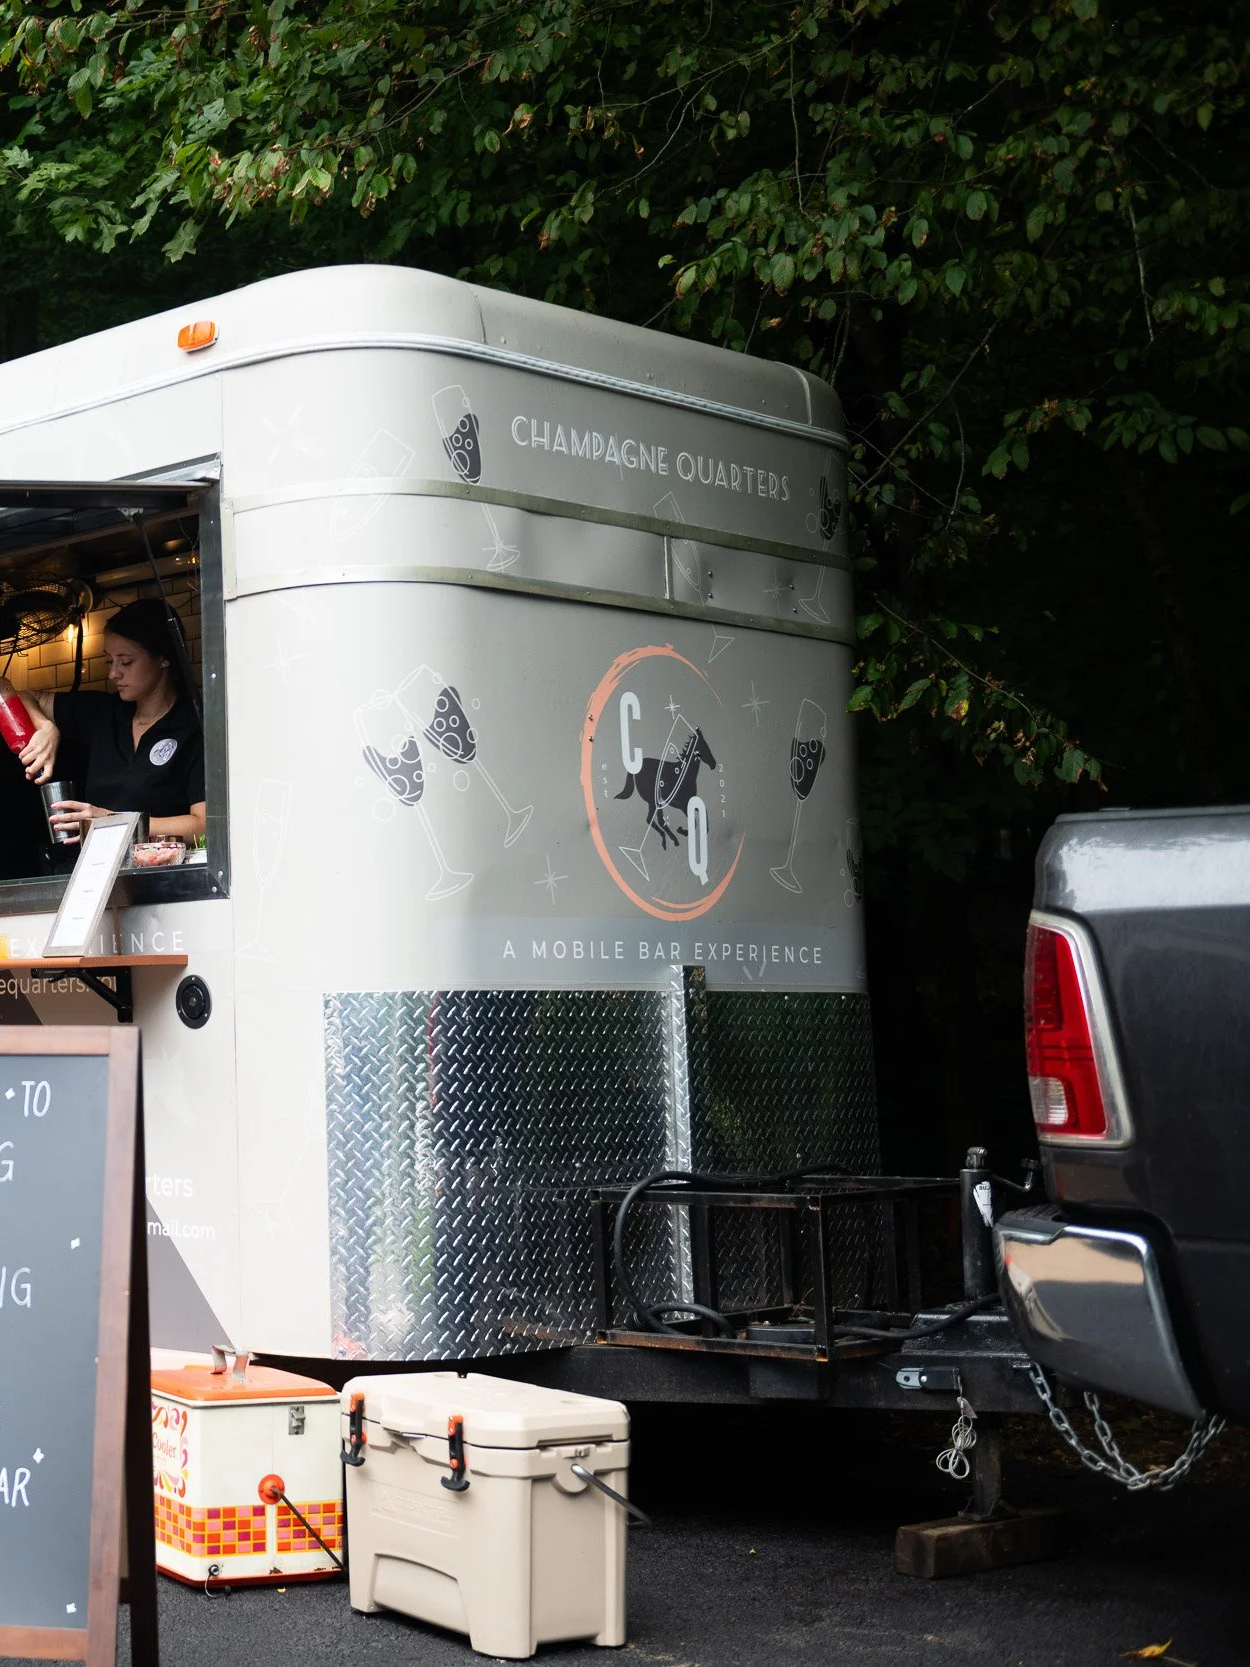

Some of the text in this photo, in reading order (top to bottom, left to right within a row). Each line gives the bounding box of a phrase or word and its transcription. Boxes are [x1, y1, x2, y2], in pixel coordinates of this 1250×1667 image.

[511, 415, 790, 501] CHAMPAGNE QUARTERS
[620, 691, 643, 775] C
[502, 940, 823, 965] A MOBILE BAR EXPERIENCE
[20, 1080, 52, 1118] TO
[147, 1219, 216, 1240] mail.com
